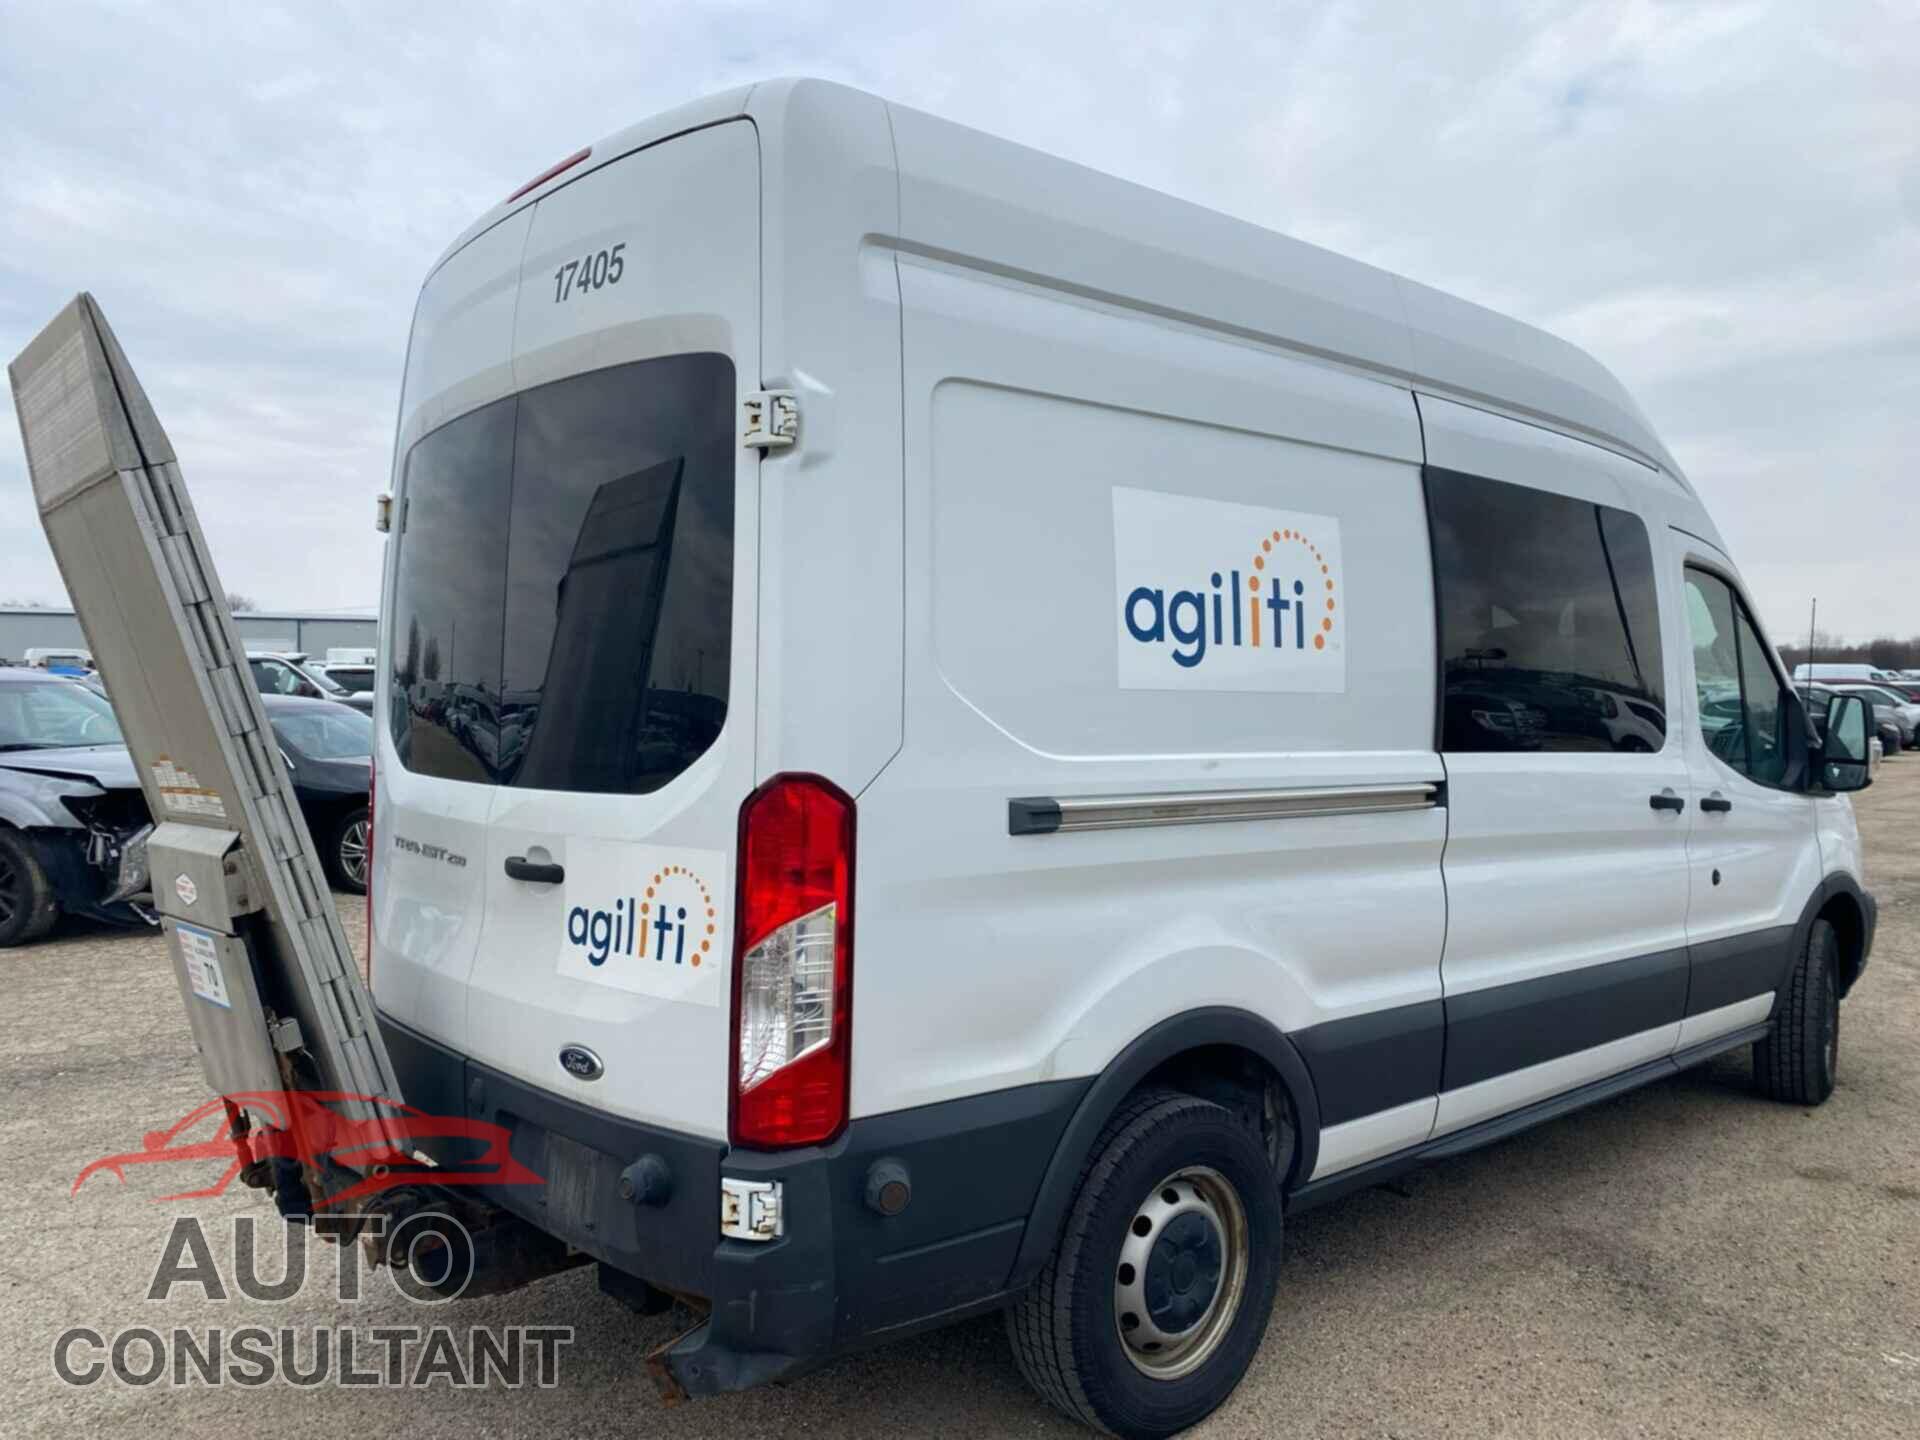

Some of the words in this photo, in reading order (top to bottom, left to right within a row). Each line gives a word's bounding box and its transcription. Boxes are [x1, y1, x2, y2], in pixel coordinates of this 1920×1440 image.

[555, 242, 626, 303] 17405
[1124, 569, 1305, 668] agiliti
[568, 897, 687, 967] agiliti
